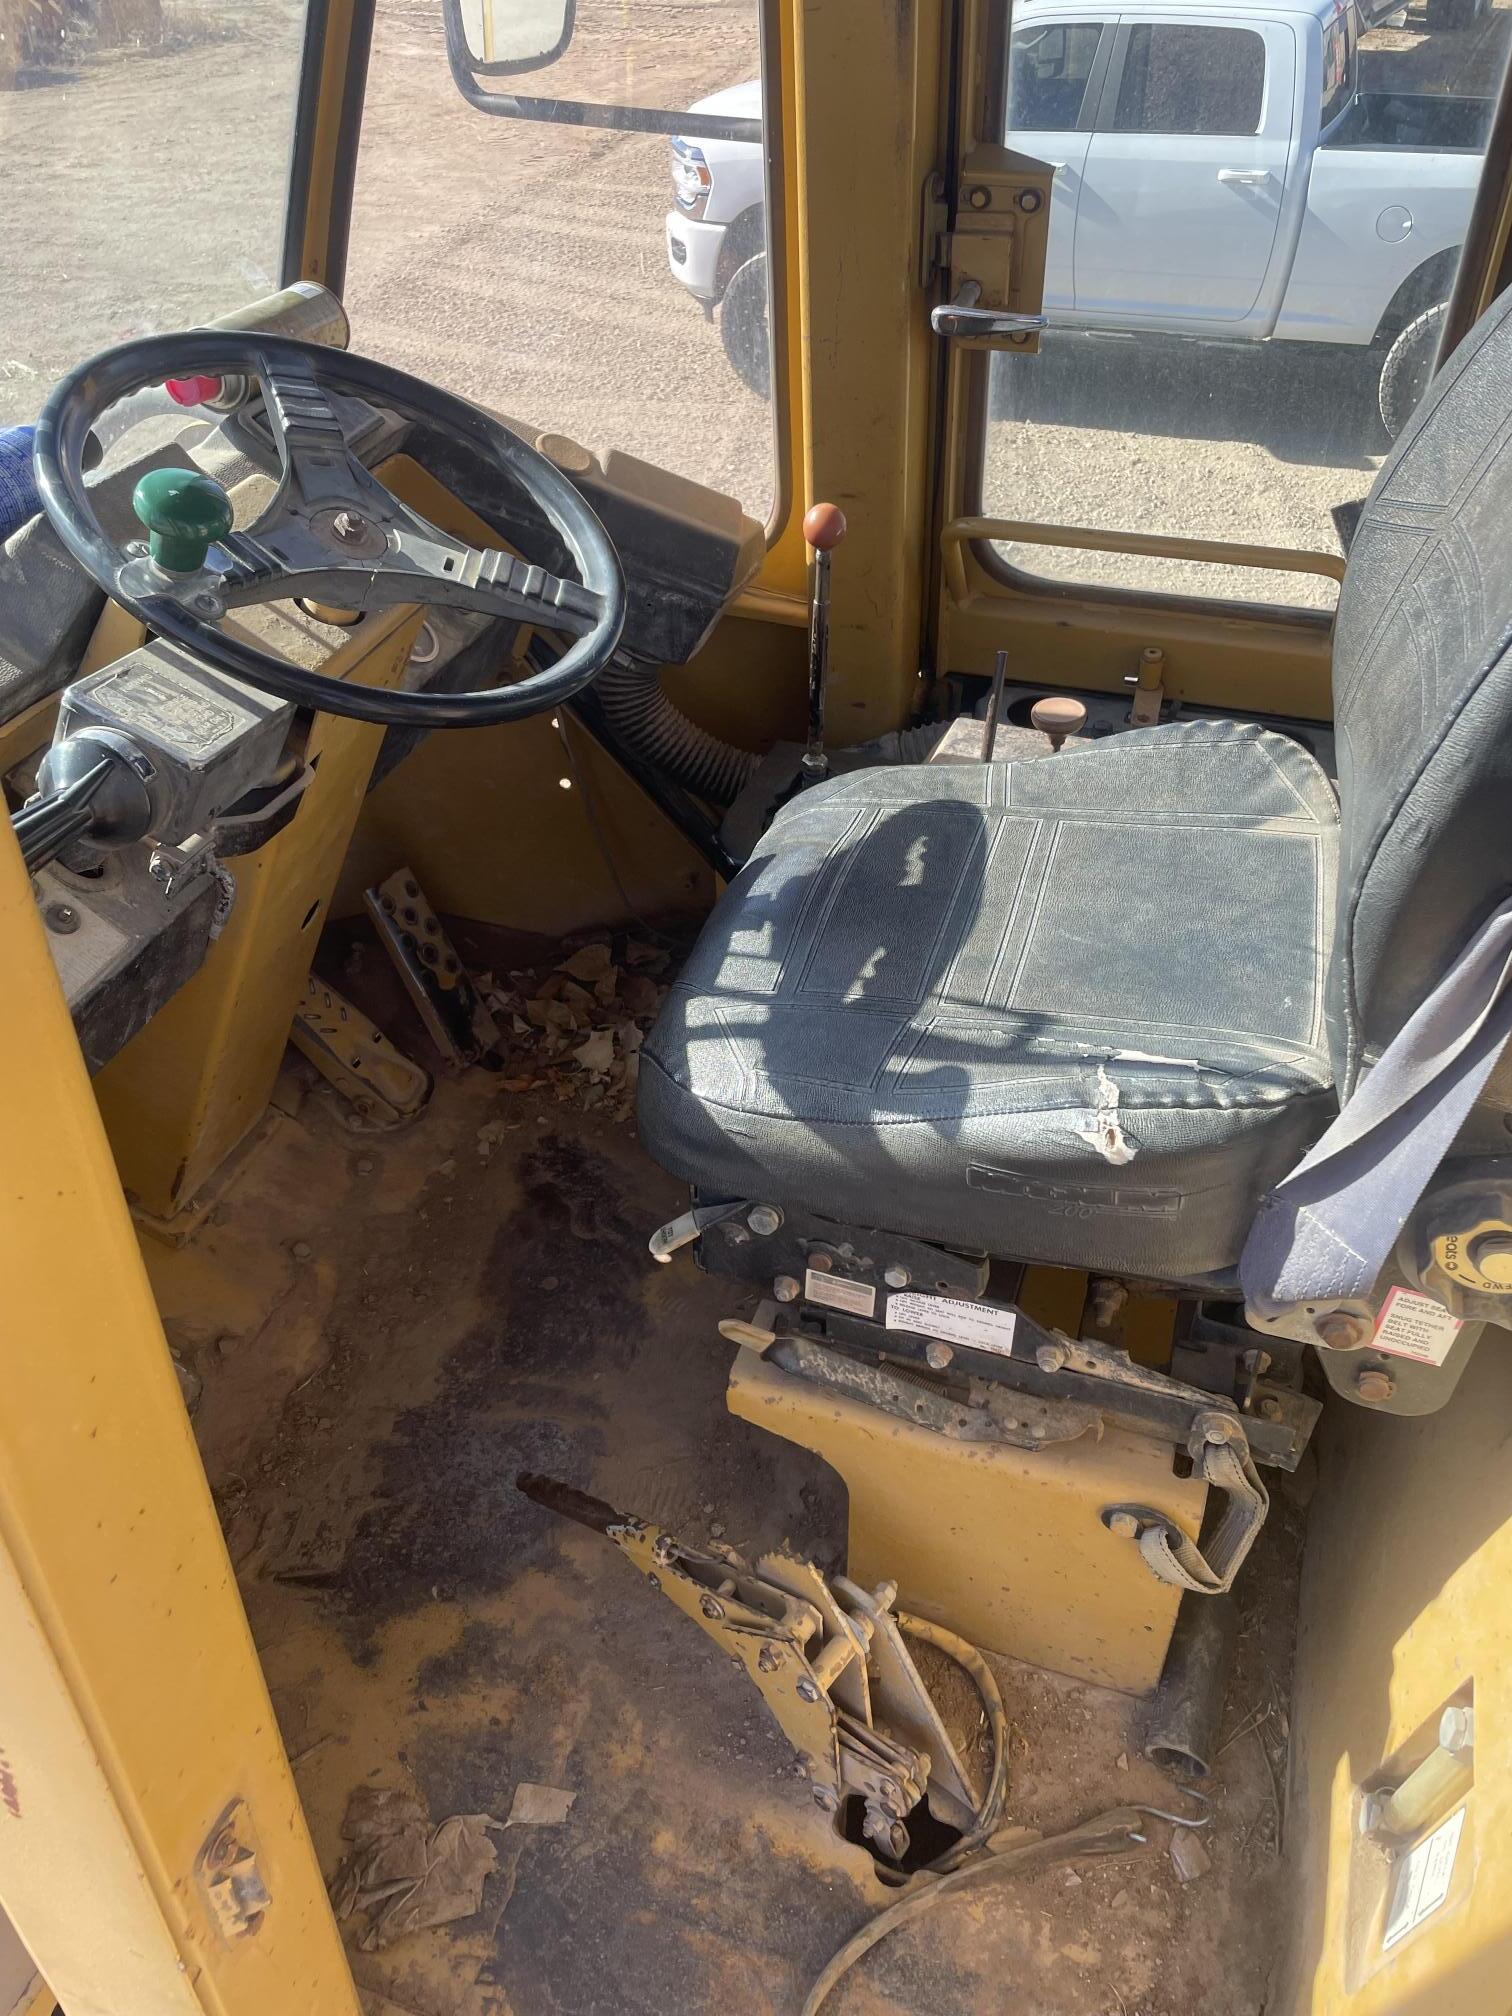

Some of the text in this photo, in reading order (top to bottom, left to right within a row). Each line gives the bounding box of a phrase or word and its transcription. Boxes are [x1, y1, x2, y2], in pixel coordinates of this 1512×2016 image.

[942, 1299, 999, 1316] ADJUSTMENT
[1395, 1302, 1417, 1312] FORE
[1418, 1308, 1436, 1316] AND
[1397, 1297, 1446, 1313] ADJUST SEA
[1387, 1318, 1429, 1333] BELT WITH
[1390, 1313, 1445, 1331] SNUG TETHER
[1382, 1330, 1429, 1345] RAISED AND
[1385, 1324, 1432, 1340] SEAT FULLY
[1379, 1335, 1431, 1352] UNOCCUPIED
